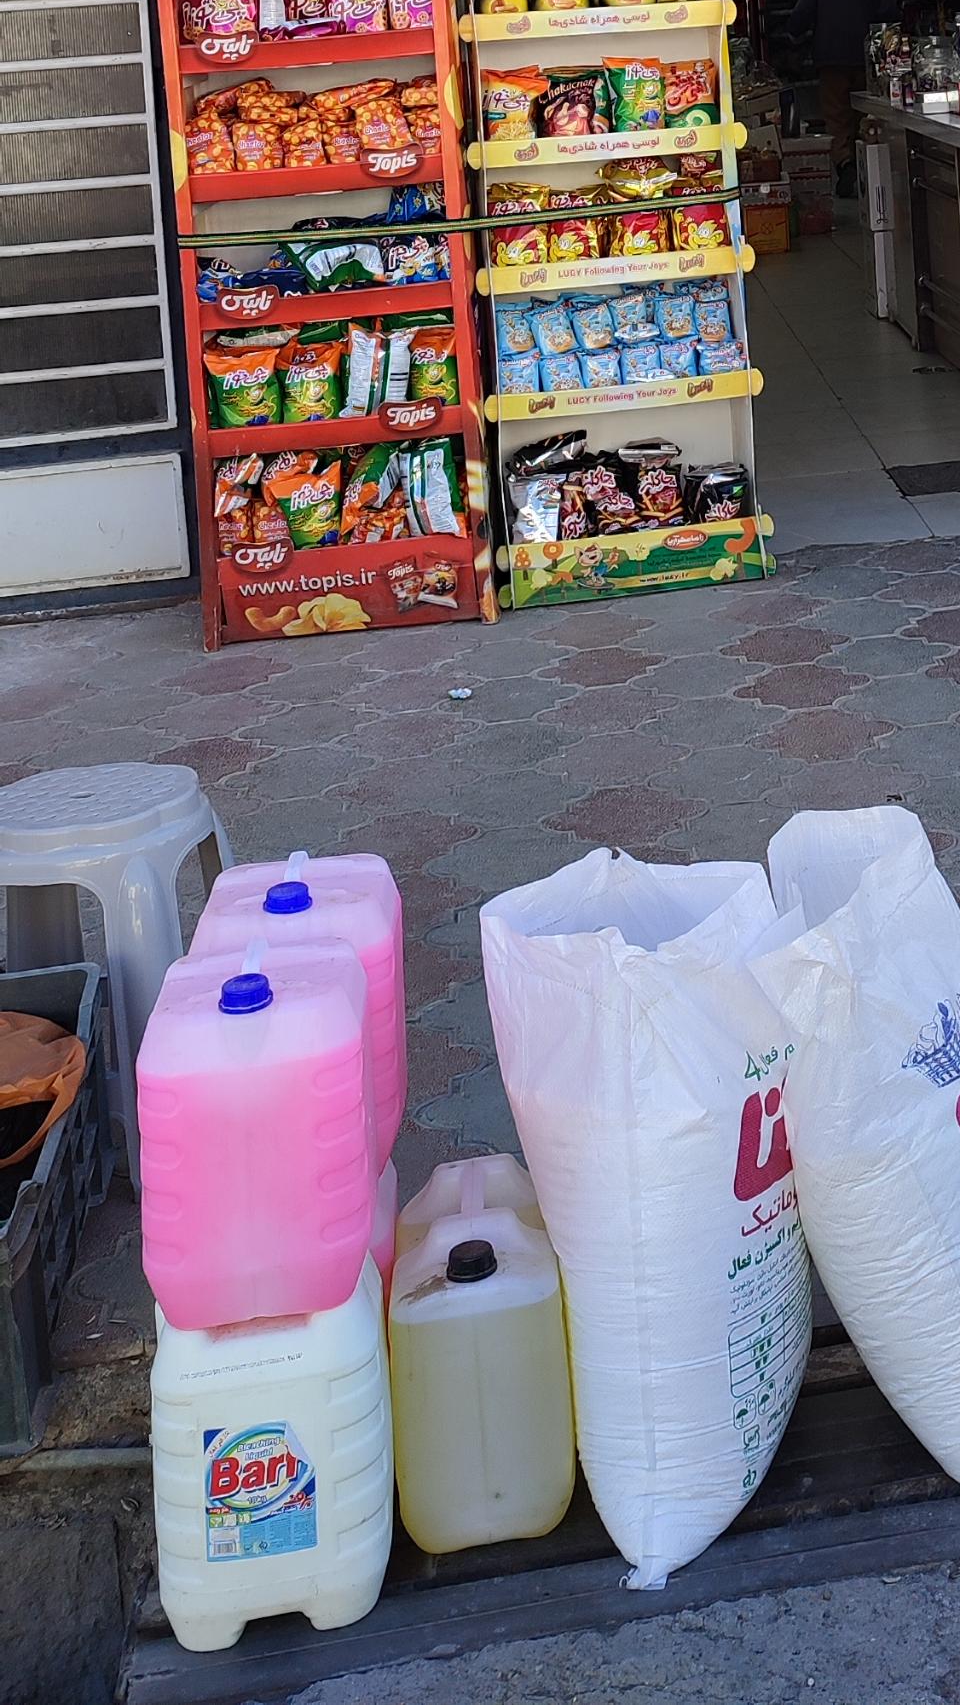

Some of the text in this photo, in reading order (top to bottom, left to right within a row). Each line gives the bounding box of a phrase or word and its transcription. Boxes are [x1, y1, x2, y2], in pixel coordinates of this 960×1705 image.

[590, 15, 620, 27] همراه
[622, 10, 650, 24] لوسی
[200, 34, 255, 61] تاپیس
[600, 141, 631, 153] همراه
[632, 136, 660, 150] لوسی
[368, 151, 418, 174] Topis
[558, 269, 581, 278] LUCY
[584, 265, 625, 275] Following
[626, 263, 646, 273] Your
[221, 292, 275, 316] تاپیس
[567, 396, 591, 405] LUCY
[593, 392, 634, 403] Following
[636, 390, 656, 399] Your
[386, 404, 436, 427] Topis
[235, 545, 289, 569] تاپیس
[388, 563, 415, 581] Topis
[239, 569, 377, 597] www.topis.ir
[727, 1249, 753, 1280] فعال
